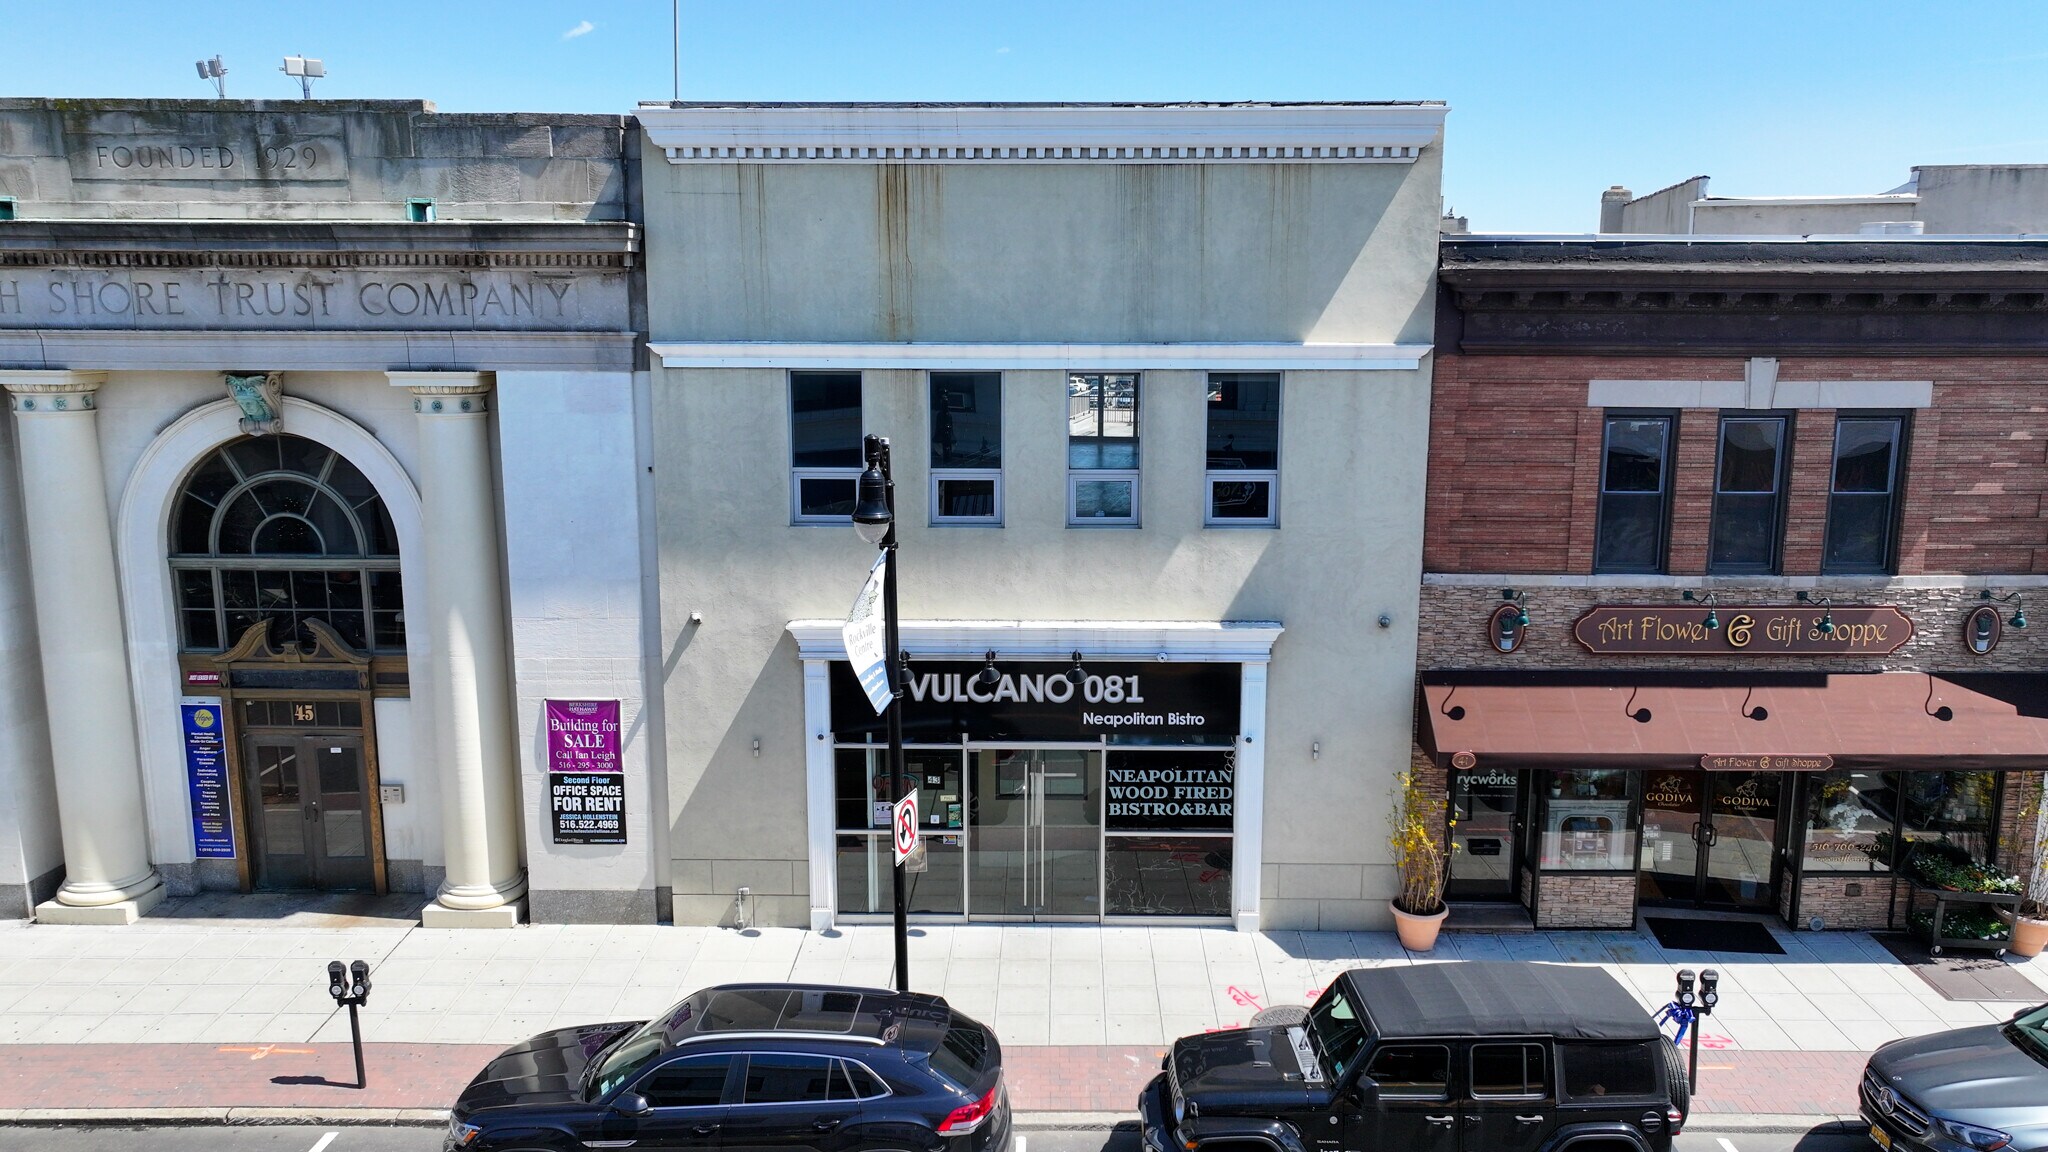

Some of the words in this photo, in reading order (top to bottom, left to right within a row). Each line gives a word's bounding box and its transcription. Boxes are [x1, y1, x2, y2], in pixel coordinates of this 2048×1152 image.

[96, 145, 234, 169] FOUNDED
[255, 146, 317, 169] 1929
[50, 281, 185, 315] SHORE
[207, 281, 335, 316] TRUST
[359, 282, 570, 316] COMPANY
[849, 622, 876, 646] Rockville
[1598, 617, 1633, 643] Art
[1640, 615, 1709, 644] Flower
[1727, 614, 1755, 647] &
[1766, 617, 1801, 647] Gift
[854, 641, 874, 657] Centre
[909, 674, 1074, 703] VULCANO
[1083, 675, 1144, 703] 081
[294, 704, 314, 721] 45
[550, 719, 599, 735] Building
[602, 719, 618, 732] for
[1083, 712, 1163, 728] Neapolitan
[1168, 712, 1205, 726] Bistro
[564, 734, 605, 748] SALE
[556, 750, 573, 759] Call
[575, 750, 589, 759] Ian
[591, 751, 616, 762] Leigh
[1713, 757, 1728, 768] Art
[1729, 757, 1757, 768] Flower
[1759, 756, 1772, 769] &
[1775, 757, 1790, 769] Gift
[1792, 757, 1822, 769] Shoppe
[563, 776, 590, 784] Second
[591, 776, 610, 784] Floor
[927, 776, 941, 784] 43
[1108, 769, 1233, 783] NEAPOLITAN
[553, 785, 588, 796] OFFICE
[590, 785, 622, 796] SPACE
[1108, 786, 1169, 799] WOOD
[1174, 786, 1233, 799] FIRED
[1646, 792, 1693, 803] GODIVA
[553, 796, 582, 811] FOR
[585, 796, 623, 811] RENT
[1722, 796, 1769, 807] GODIVA
[1108, 802, 1233, 816] BISTRO&BAR
[560, 820, 619, 829] 516.522.4969
